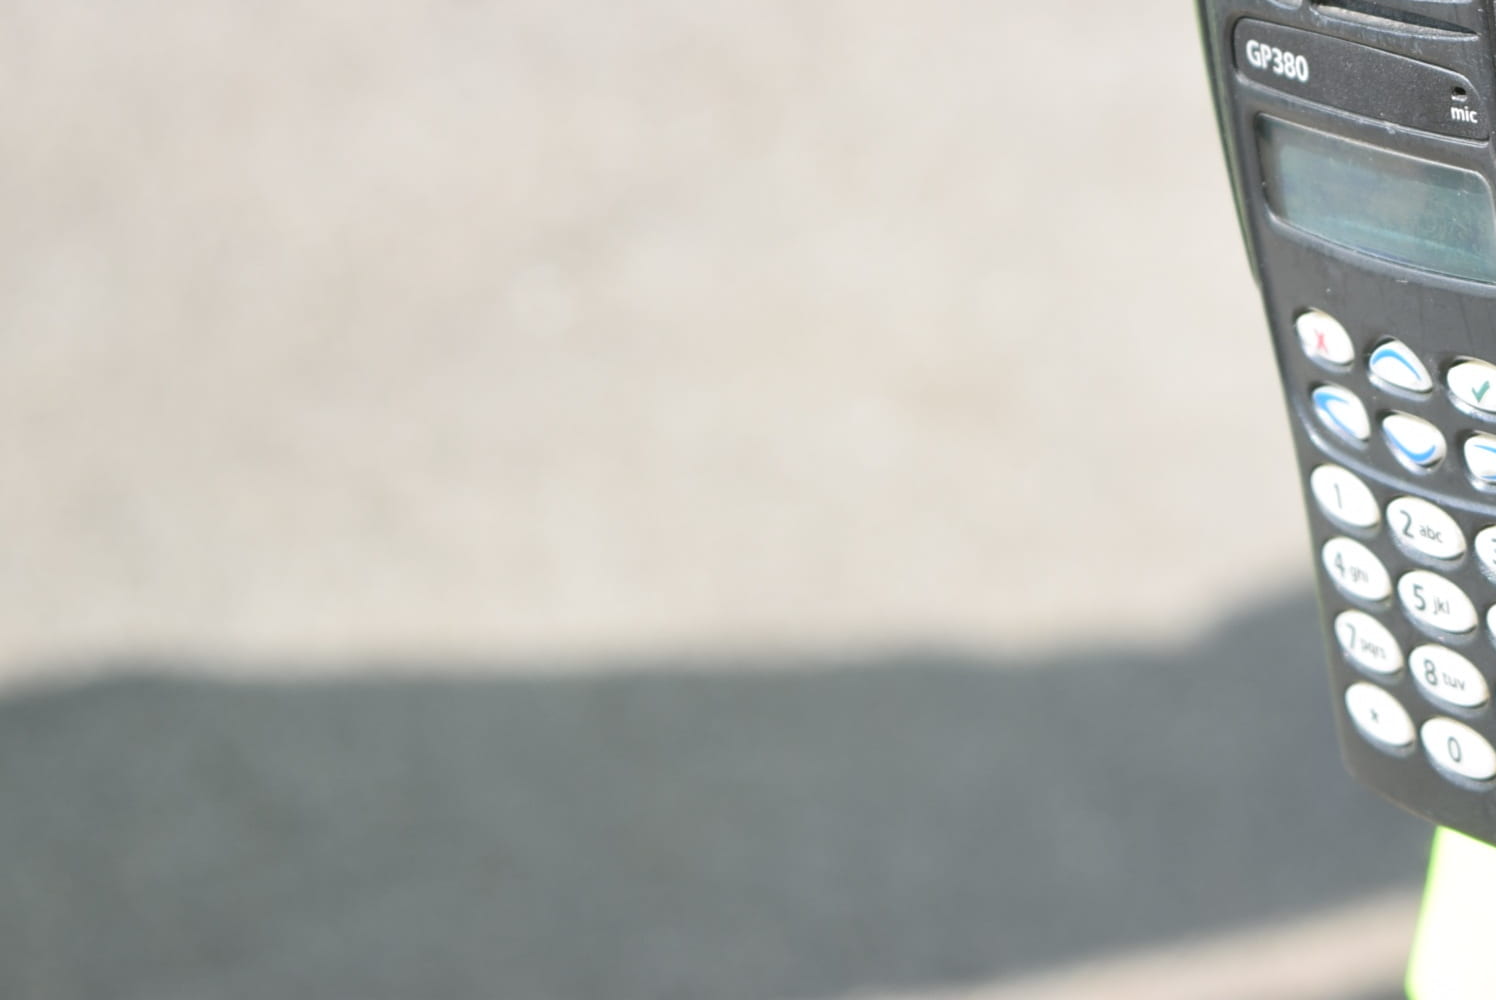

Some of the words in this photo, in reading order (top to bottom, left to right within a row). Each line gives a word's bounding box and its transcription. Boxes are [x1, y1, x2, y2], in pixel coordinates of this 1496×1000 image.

[1246, 39, 1310, 82] GP380
[1451, 106, 1478, 124] mic
[1334, 483, 1342, 509] 1
[1400, 509, 1414, 538] 2
[1419, 524, 1443, 543] abc
[1334, 552, 1345, 577] 4
[1412, 584, 1426, 611] 5
[1345, 622, 1356, 649] 7
[1423, 658, 1438, 686] 8
[1443, 672, 1466, 692] tuv
